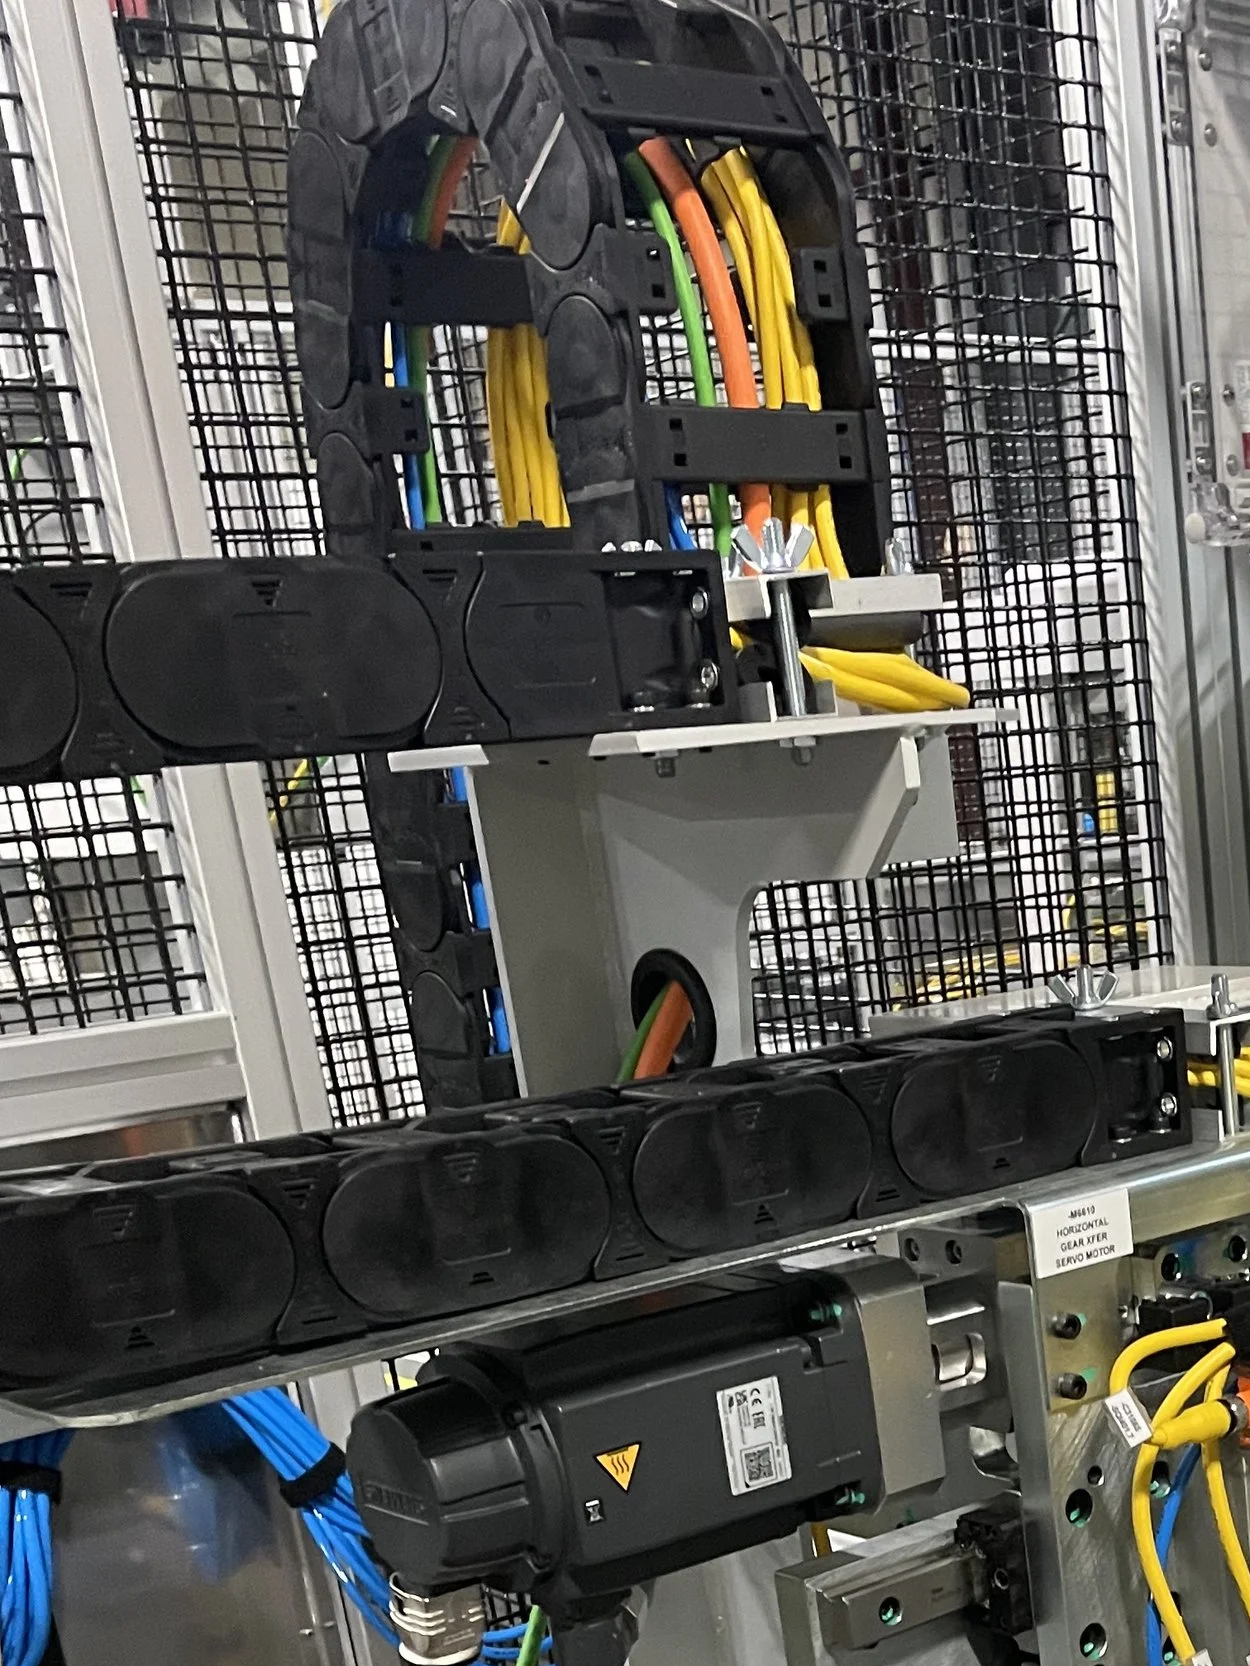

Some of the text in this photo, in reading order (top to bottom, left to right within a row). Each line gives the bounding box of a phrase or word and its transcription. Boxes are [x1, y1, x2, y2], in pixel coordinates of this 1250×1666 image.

[1056, 1217, 1109, 1238] HORIZONTAL
[1060, 1232, 1108, 1252] GEAR XFER
[1055, 1244, 1116, 1269] SERVO MOTOR
